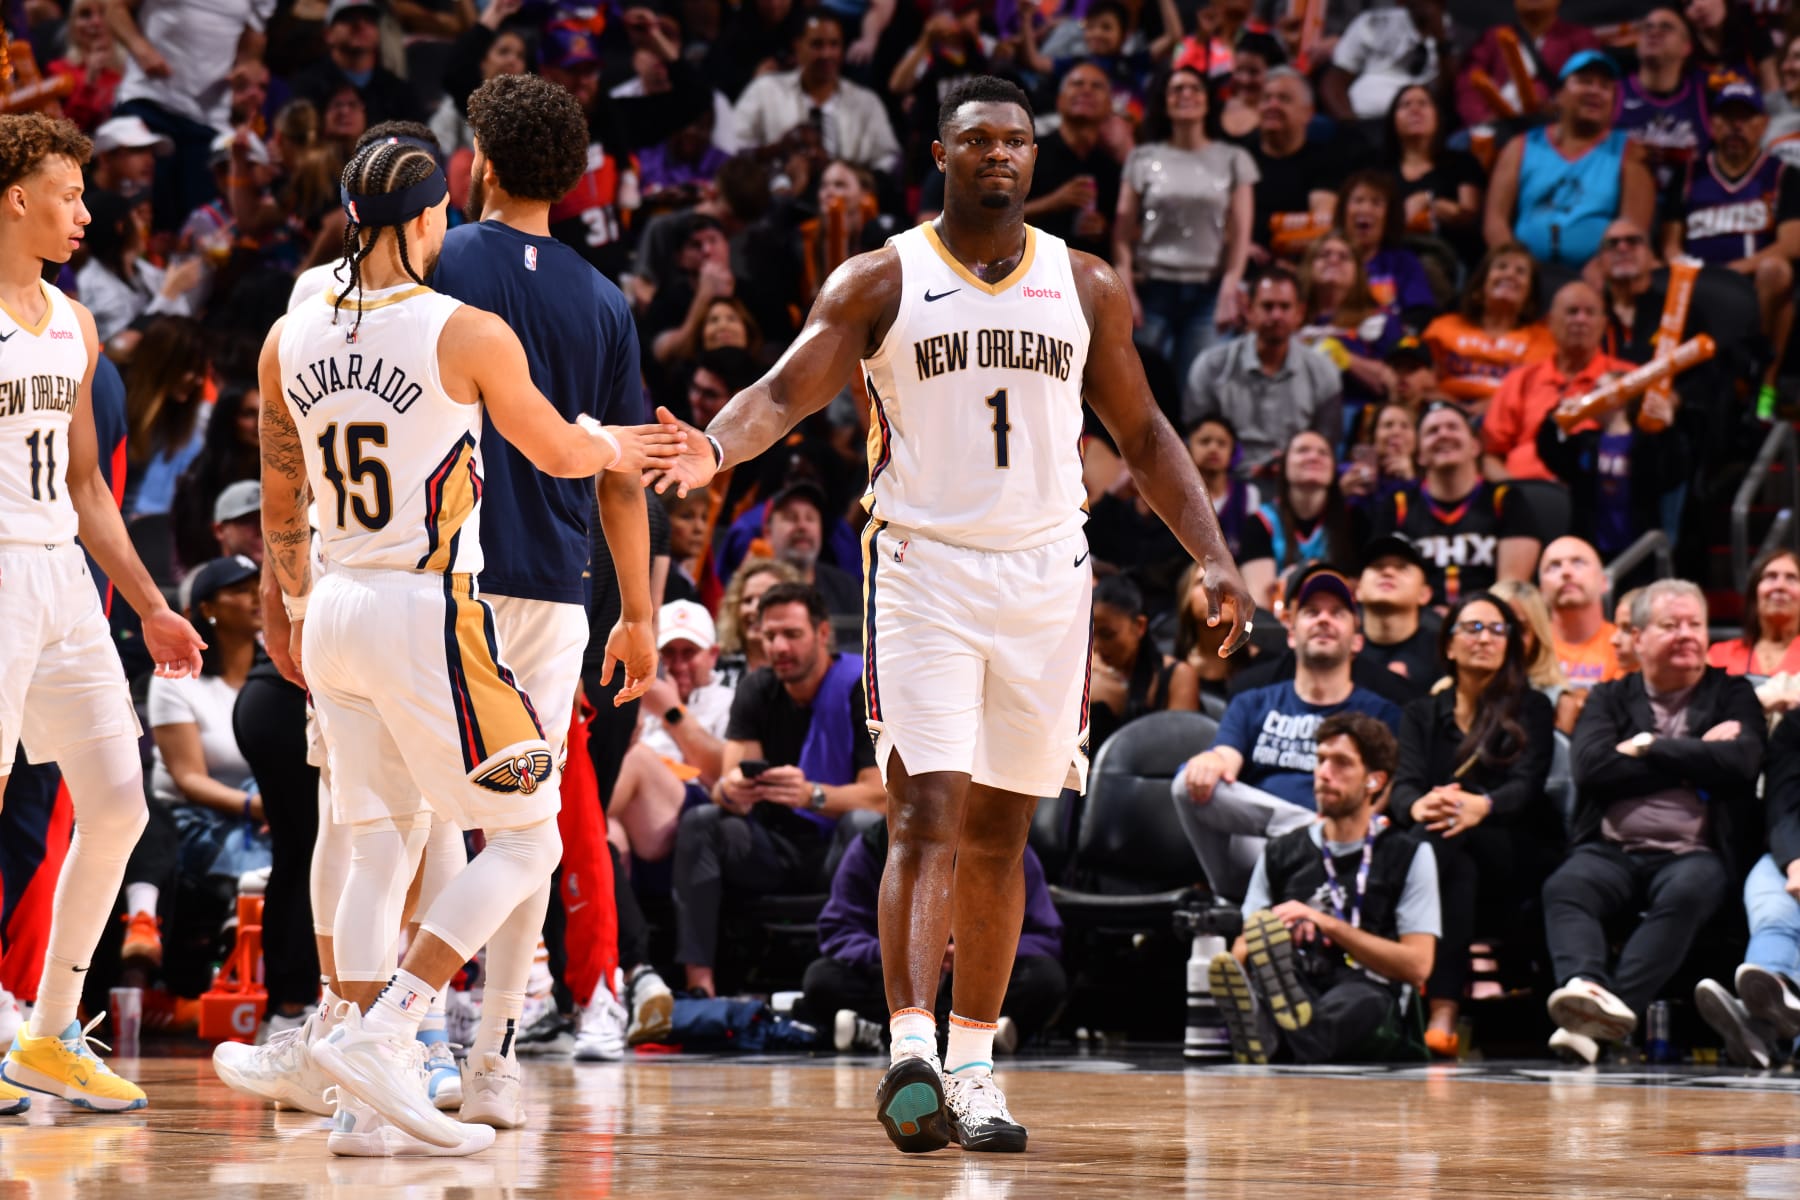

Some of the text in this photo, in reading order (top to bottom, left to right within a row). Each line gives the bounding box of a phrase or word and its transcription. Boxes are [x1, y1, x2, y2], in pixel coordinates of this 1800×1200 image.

[1023, 286, 1061, 299] ibotta
[49, 328, 74, 340] ibotta
[913, 328, 1073, 382] NEW ORLEANS
[0, 374, 80, 417] EW ORLEAN
[287, 354, 423, 417] ALVARADO
[984, 387, 1012, 470] 1
[25, 429, 57, 502] 11
[317, 421, 394, 533] 15
[231, 1002, 257, 1035] G
